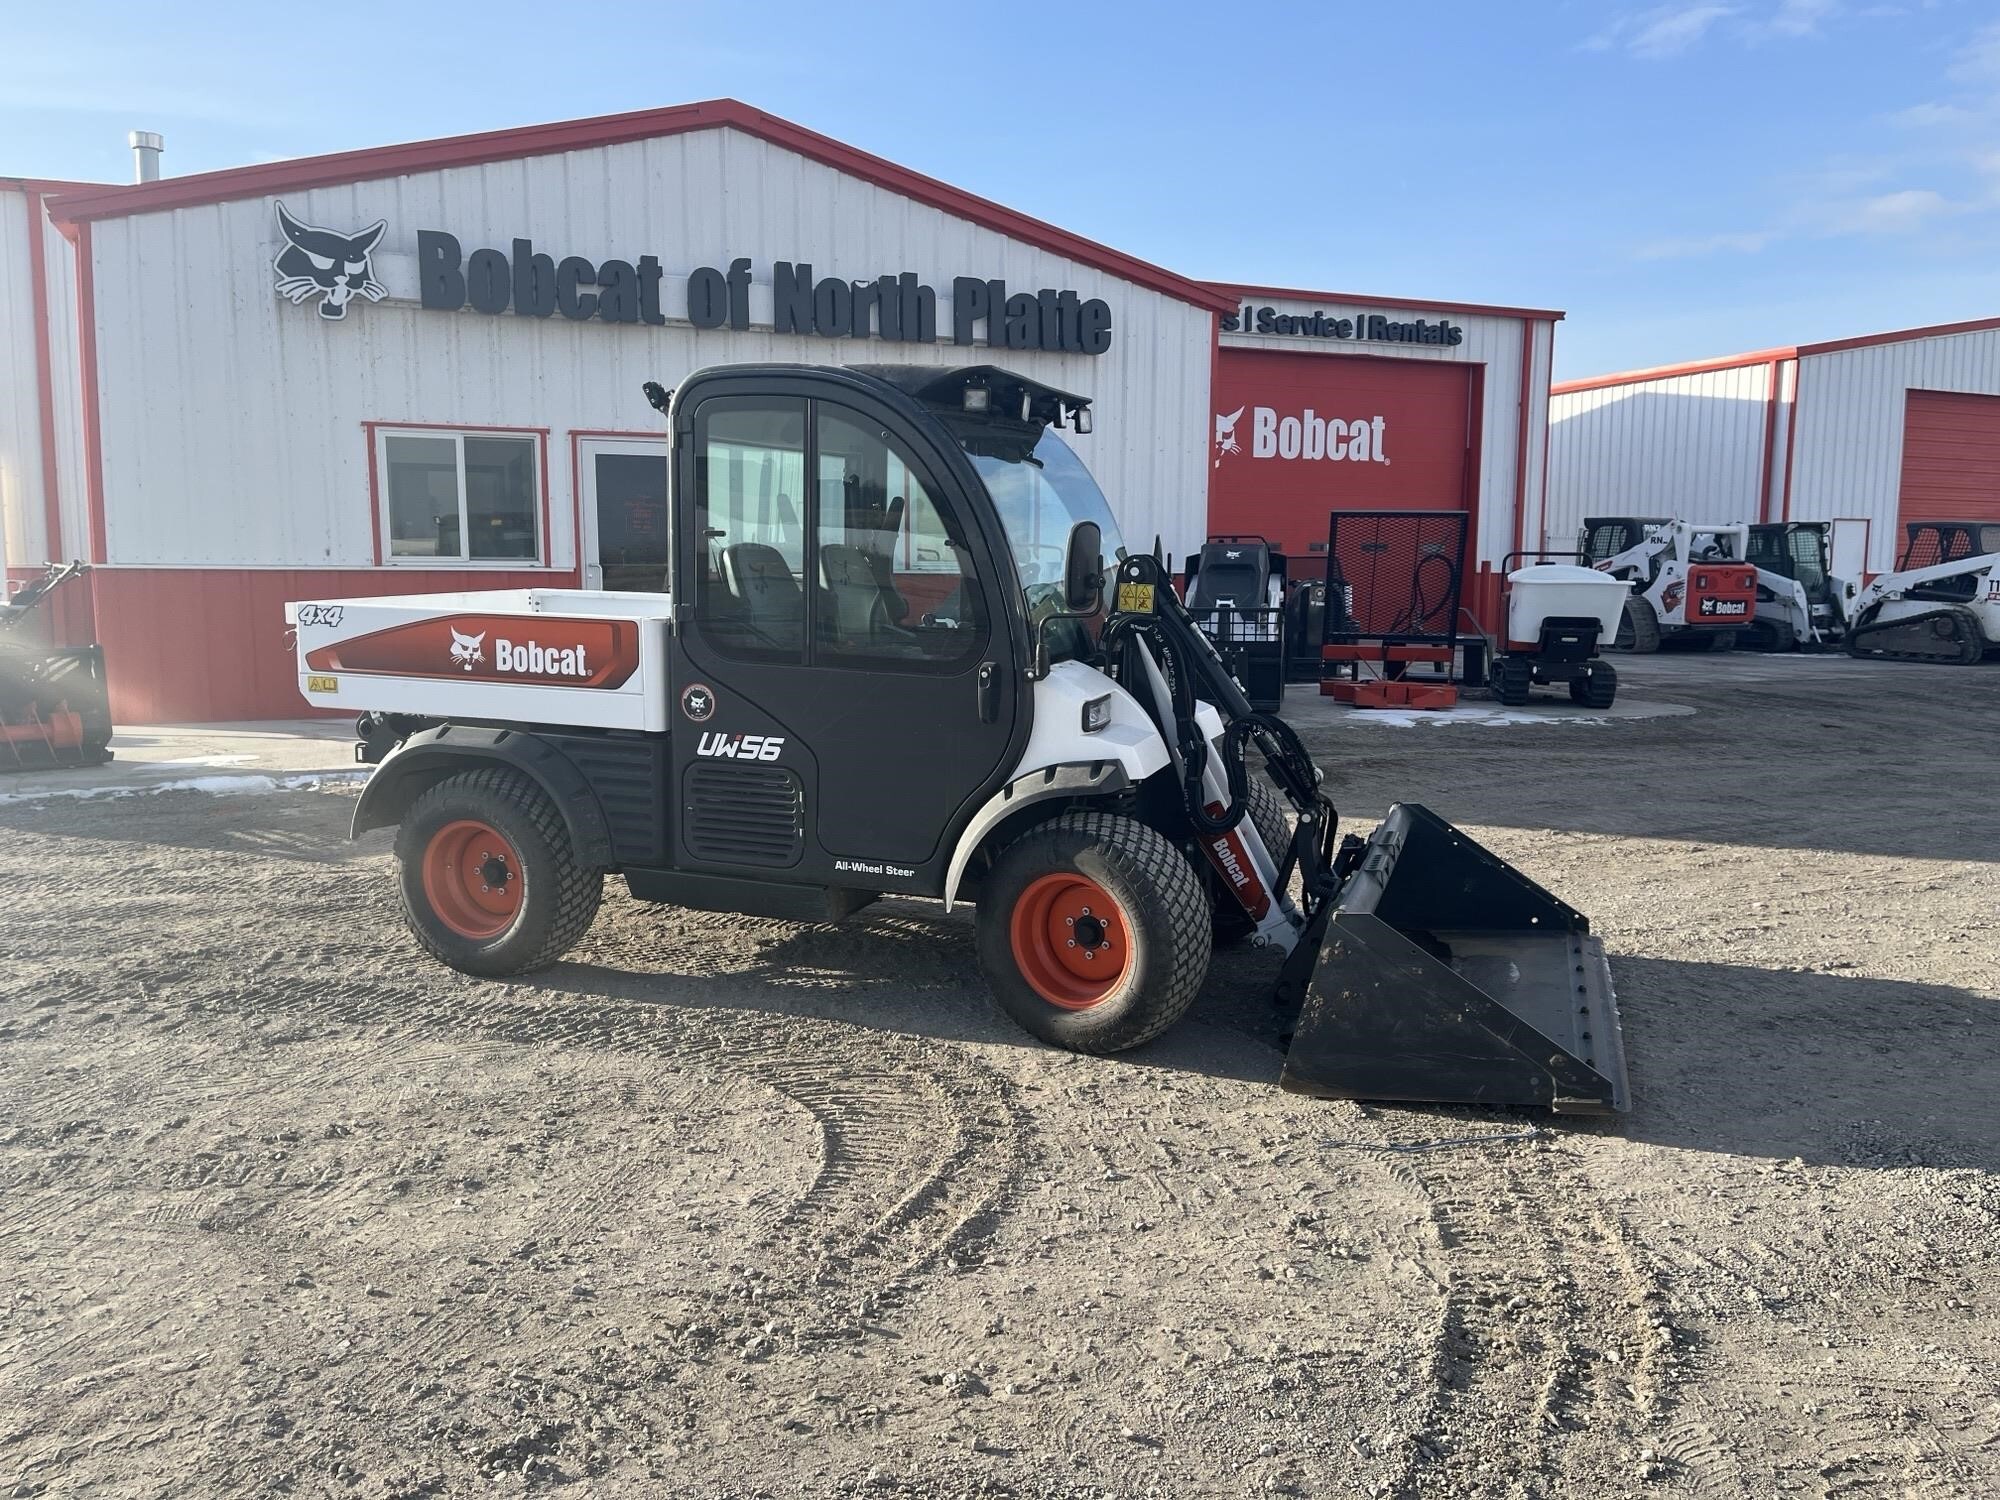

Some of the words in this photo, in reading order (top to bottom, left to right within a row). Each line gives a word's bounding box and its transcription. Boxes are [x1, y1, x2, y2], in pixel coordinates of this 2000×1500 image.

[417, 229, 665, 326] Bobcat
[687, 257, 752, 331] of
[773, 261, 937, 343] North
[952, 276, 1112, 356] Platte
[1257, 306, 1353, 339] Service
[1368, 315, 1463, 346] Rentals
[1252, 406, 1386, 462] Bobcat
[299, 605, 343, 627] 4x4
[1716, 602, 1745, 614] Bobcat
[495, 639, 588, 676] Bobcat
[696, 732, 785, 761] UW56
[835, 860, 883, 875] All-Wheel
[886, 865, 915, 878] Steer
[1212, 837, 1250, 888] Bobcat
